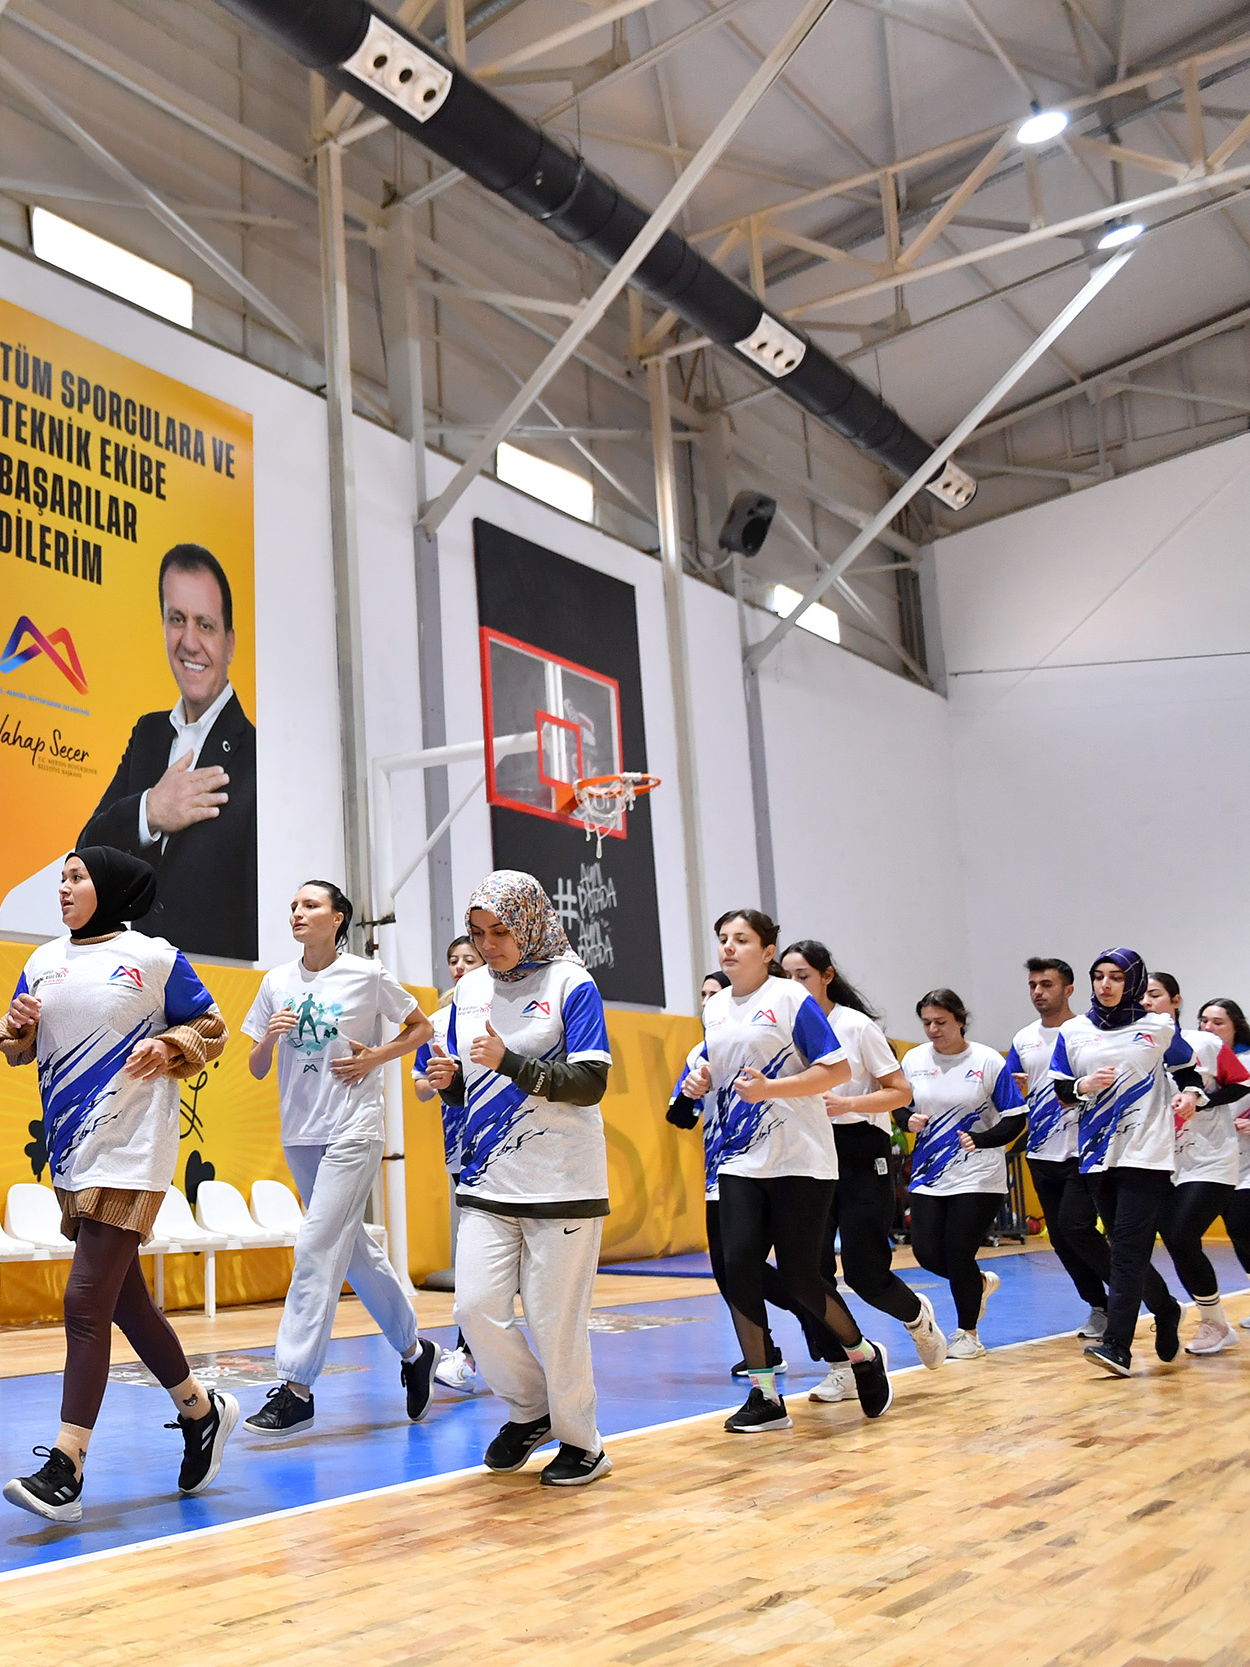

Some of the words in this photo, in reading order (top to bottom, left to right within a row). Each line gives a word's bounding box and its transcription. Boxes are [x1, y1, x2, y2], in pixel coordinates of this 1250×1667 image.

[0, 341, 52, 400] TÜM
[61, 370, 206, 467] SPORCULARA
[211, 436, 236, 480] VE
[100, 436, 167, 501] EKİBE
[49, 729, 90, 763] Seçer
[532, 1071, 546, 1094] LACOSTE
